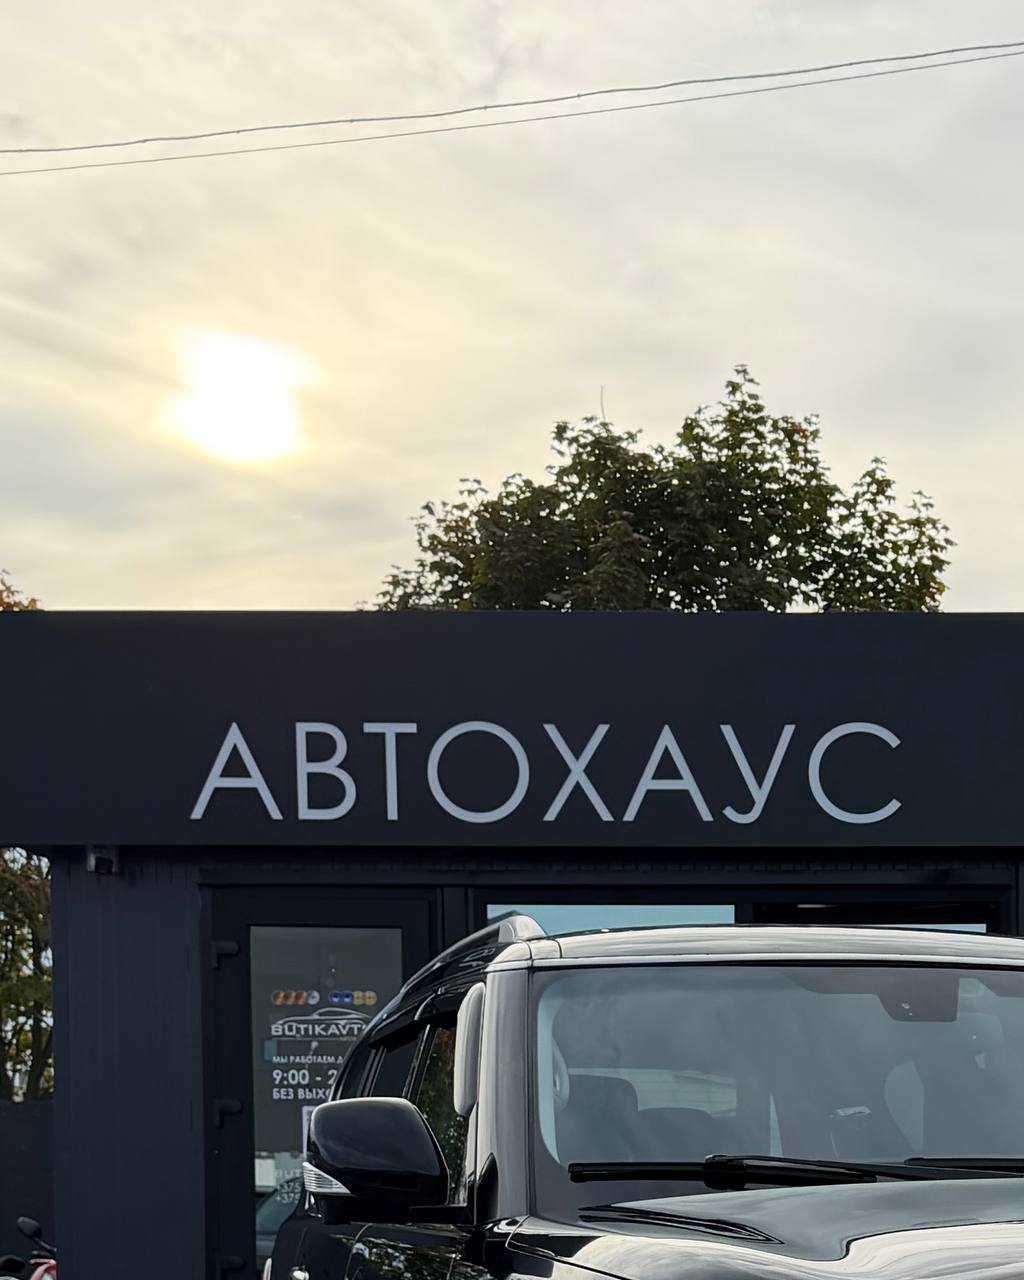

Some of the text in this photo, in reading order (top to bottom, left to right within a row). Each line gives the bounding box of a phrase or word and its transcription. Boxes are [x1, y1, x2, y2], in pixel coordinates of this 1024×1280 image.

[190, 721, 902, 824] АВТОХАУС
[272, 1069, 310, 1085] 9:00
[272, 1088, 294, 1099] БЕЗ
